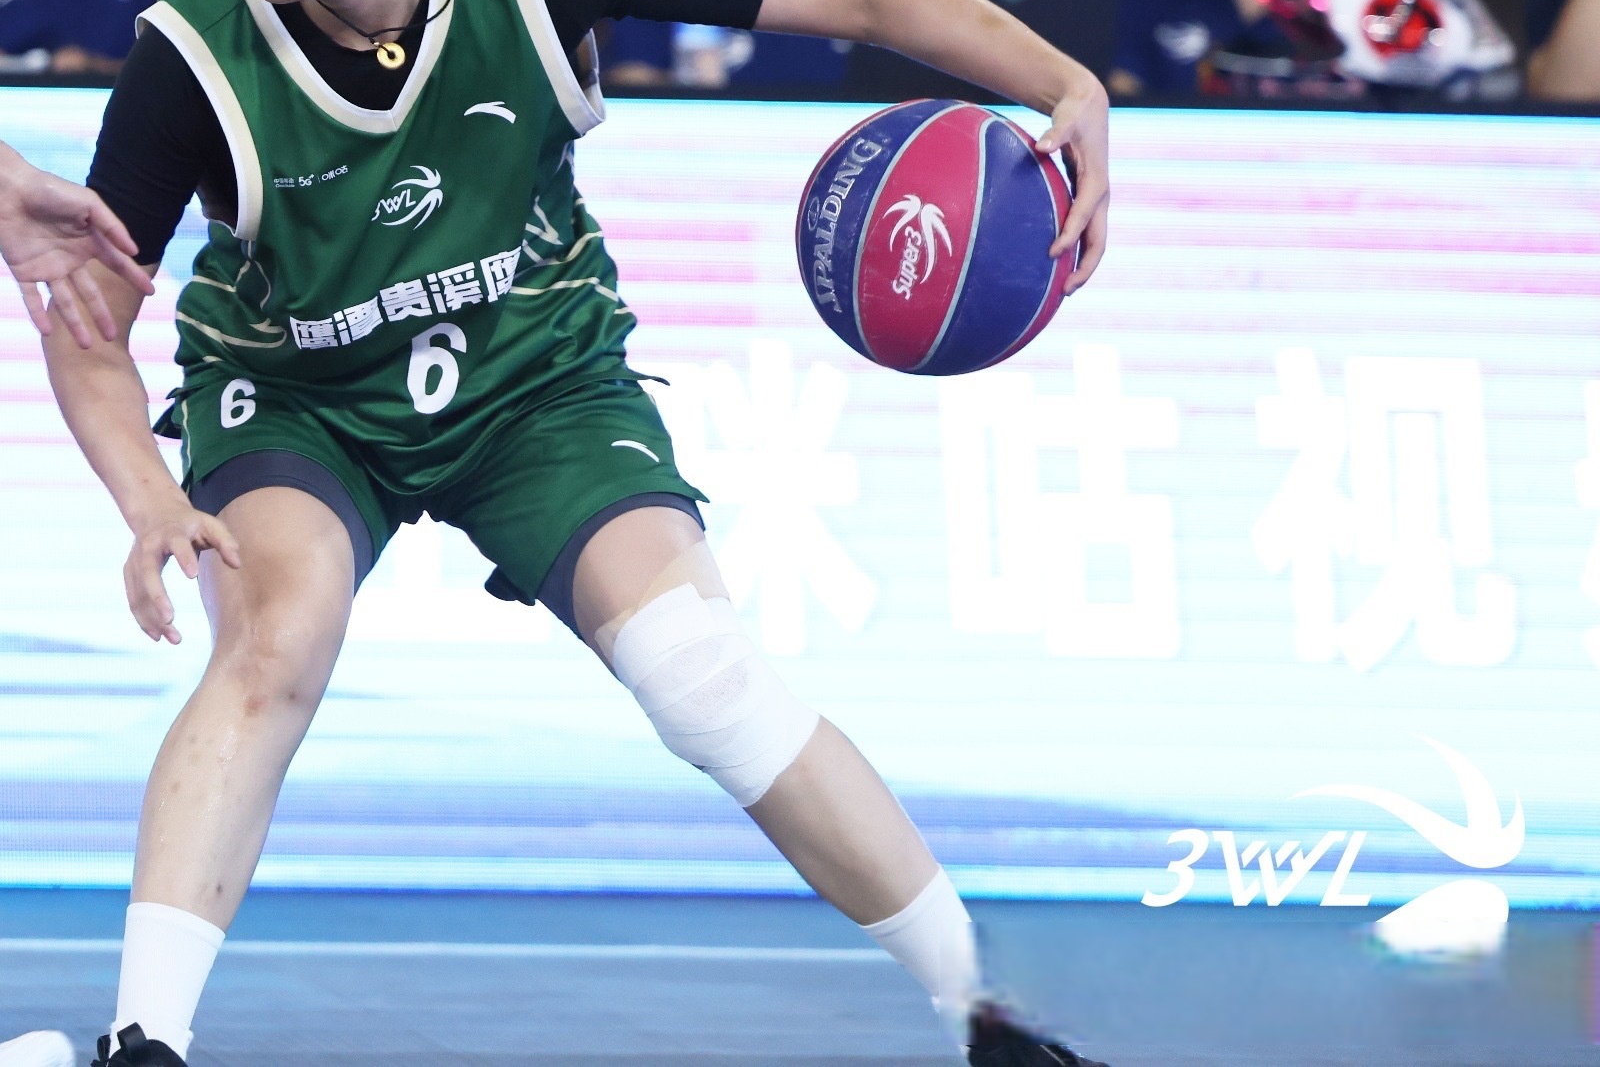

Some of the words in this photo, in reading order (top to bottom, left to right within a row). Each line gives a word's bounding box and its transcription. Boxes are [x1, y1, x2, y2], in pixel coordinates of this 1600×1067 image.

[813, 137, 882, 313] SPALDING
[220, 378, 256, 429] 6
[406, 322, 467, 415] 6
